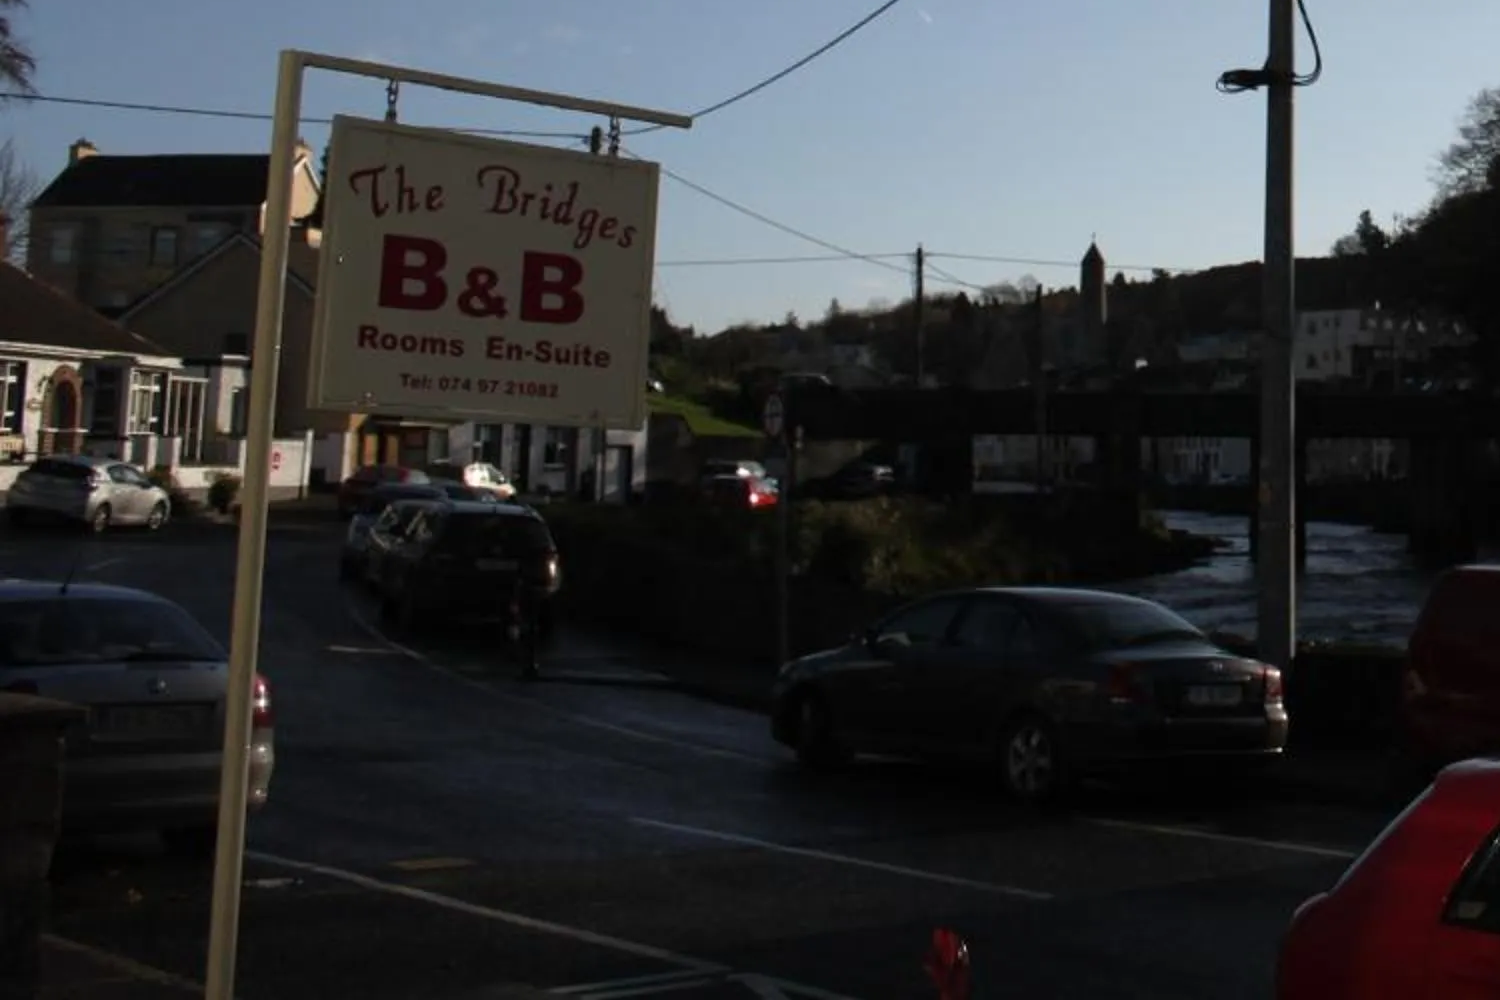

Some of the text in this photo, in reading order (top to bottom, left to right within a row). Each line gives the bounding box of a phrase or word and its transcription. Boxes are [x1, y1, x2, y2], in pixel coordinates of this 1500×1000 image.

[349, 164, 638, 249] The Bridges
[378, 234, 584, 324] B&B
[358, 325, 611, 368] Rooms En-Suite
[401, 373, 432, 391] Tel:
[438, 376, 471, 392] 074
[477, 379, 498, 394] 97
